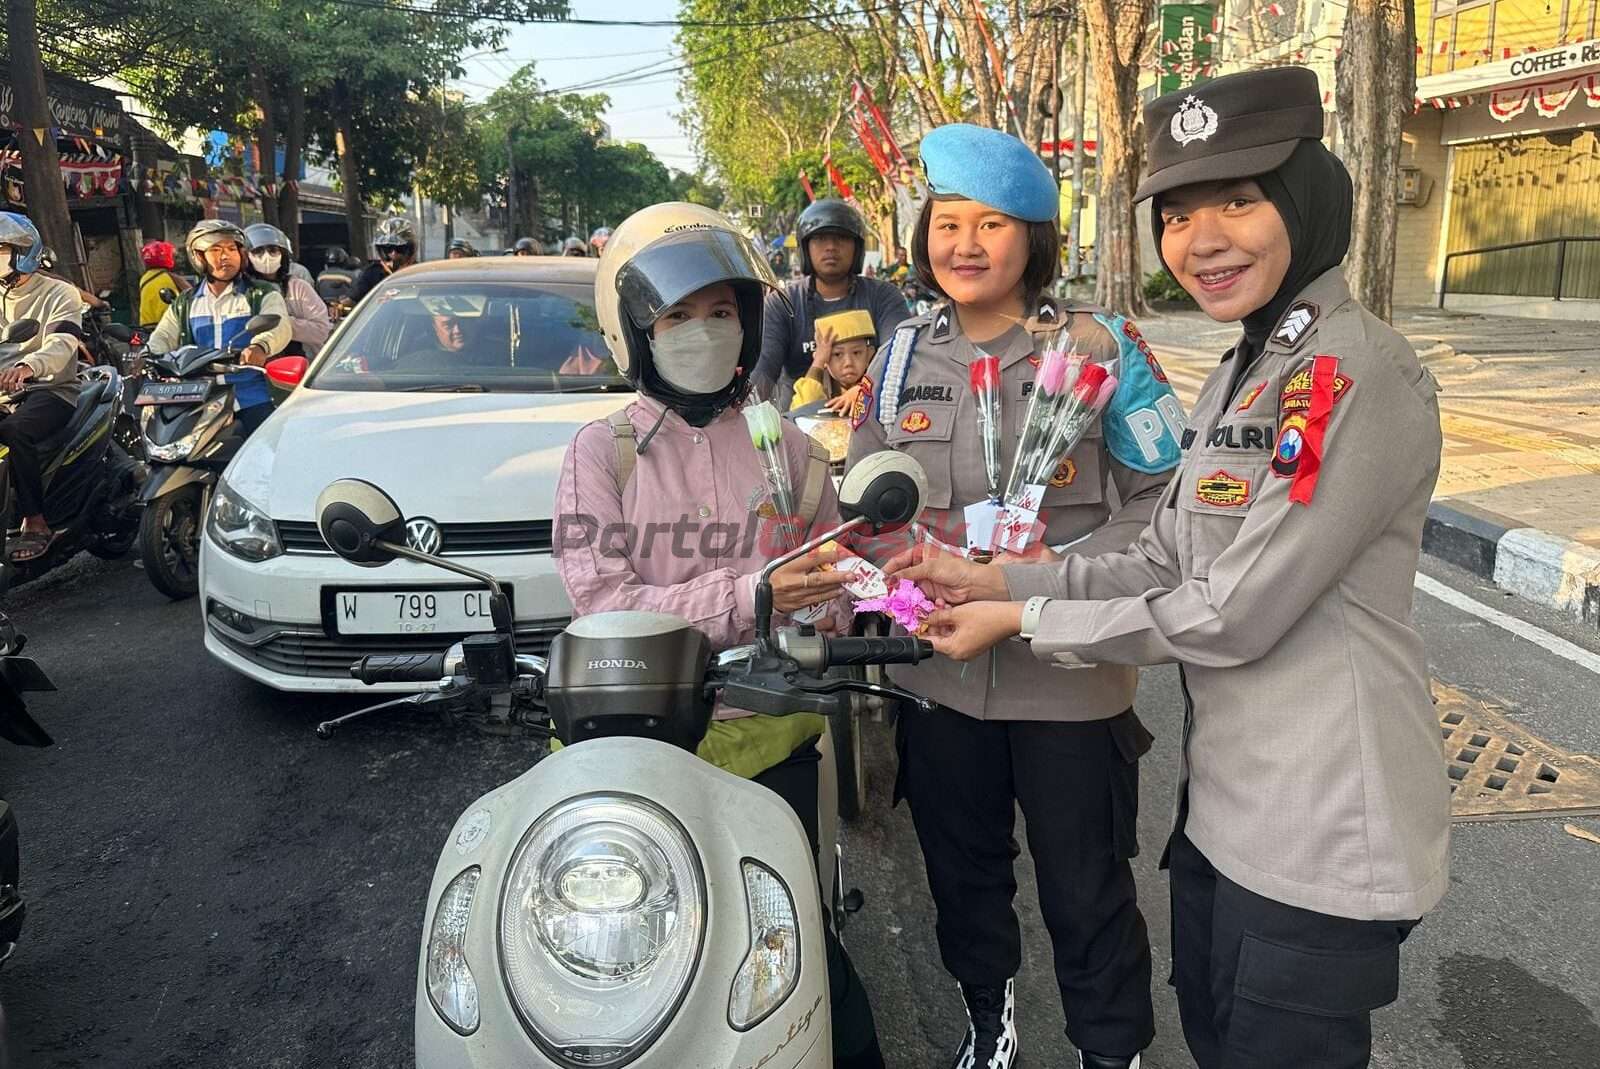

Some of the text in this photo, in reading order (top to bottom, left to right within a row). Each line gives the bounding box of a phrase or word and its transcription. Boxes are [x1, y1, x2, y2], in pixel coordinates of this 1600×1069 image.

[1511, 50, 1567, 76] COFFEE
[1007, 521, 1021, 537] 76
[343, 593, 491, 620] W 799 CL
[588, 659, 648, 669] HONDA
